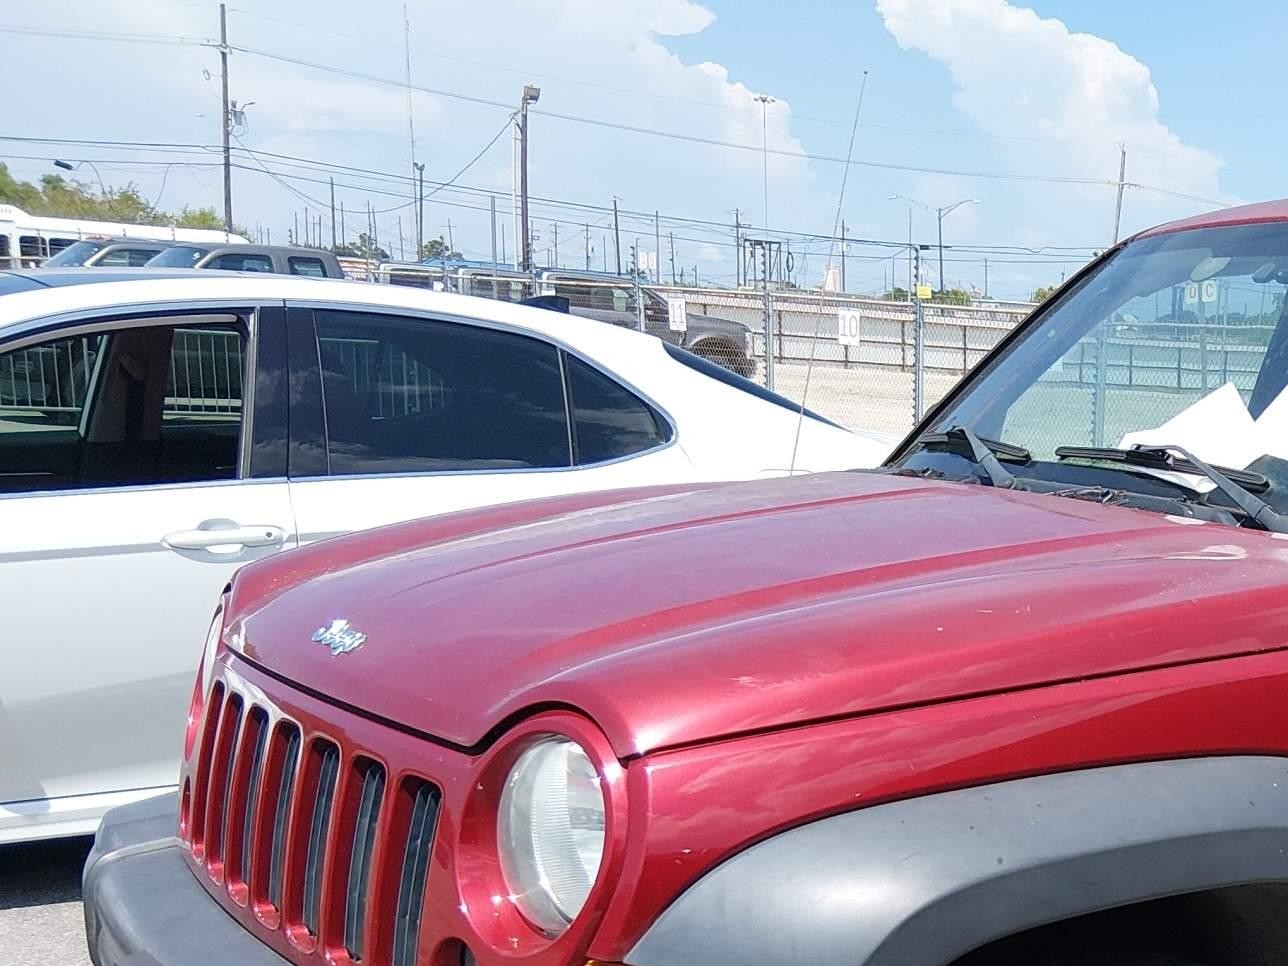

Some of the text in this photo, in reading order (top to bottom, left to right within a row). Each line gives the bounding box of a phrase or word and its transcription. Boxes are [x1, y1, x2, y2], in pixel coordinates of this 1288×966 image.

[1205, 283, 1214, 298] C
[669, 302, 684, 324] 11
[840, 314, 858, 338] 10
